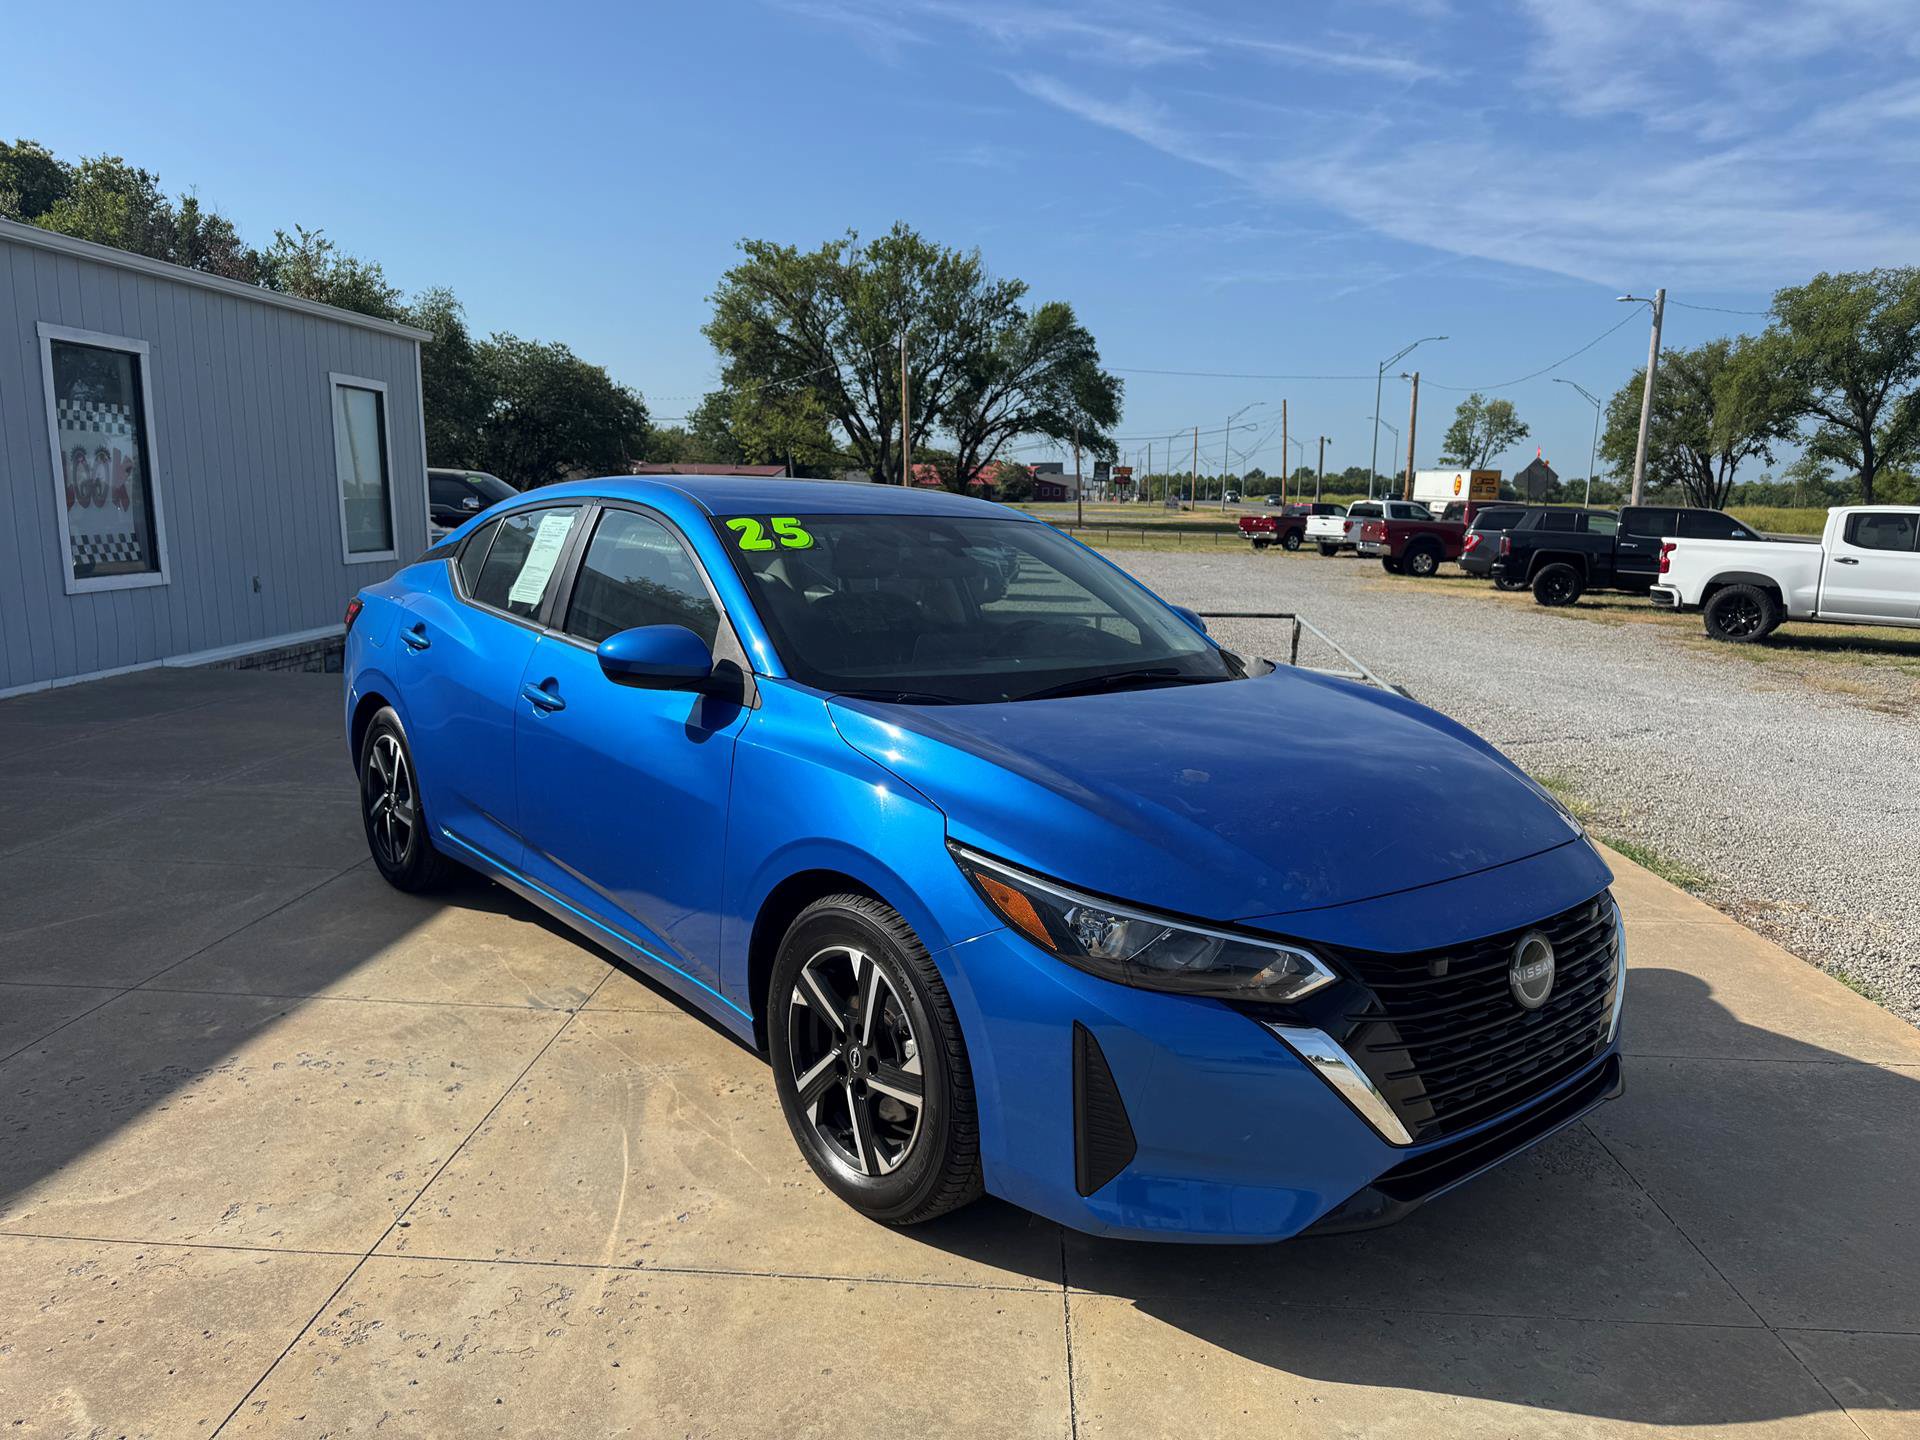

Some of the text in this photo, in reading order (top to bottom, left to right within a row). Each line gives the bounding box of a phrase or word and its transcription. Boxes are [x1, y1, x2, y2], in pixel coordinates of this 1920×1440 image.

[61, 447, 133, 512] LOOK
[725, 517, 814, 551] 25
[1513, 959, 1553, 981] NISSAN
